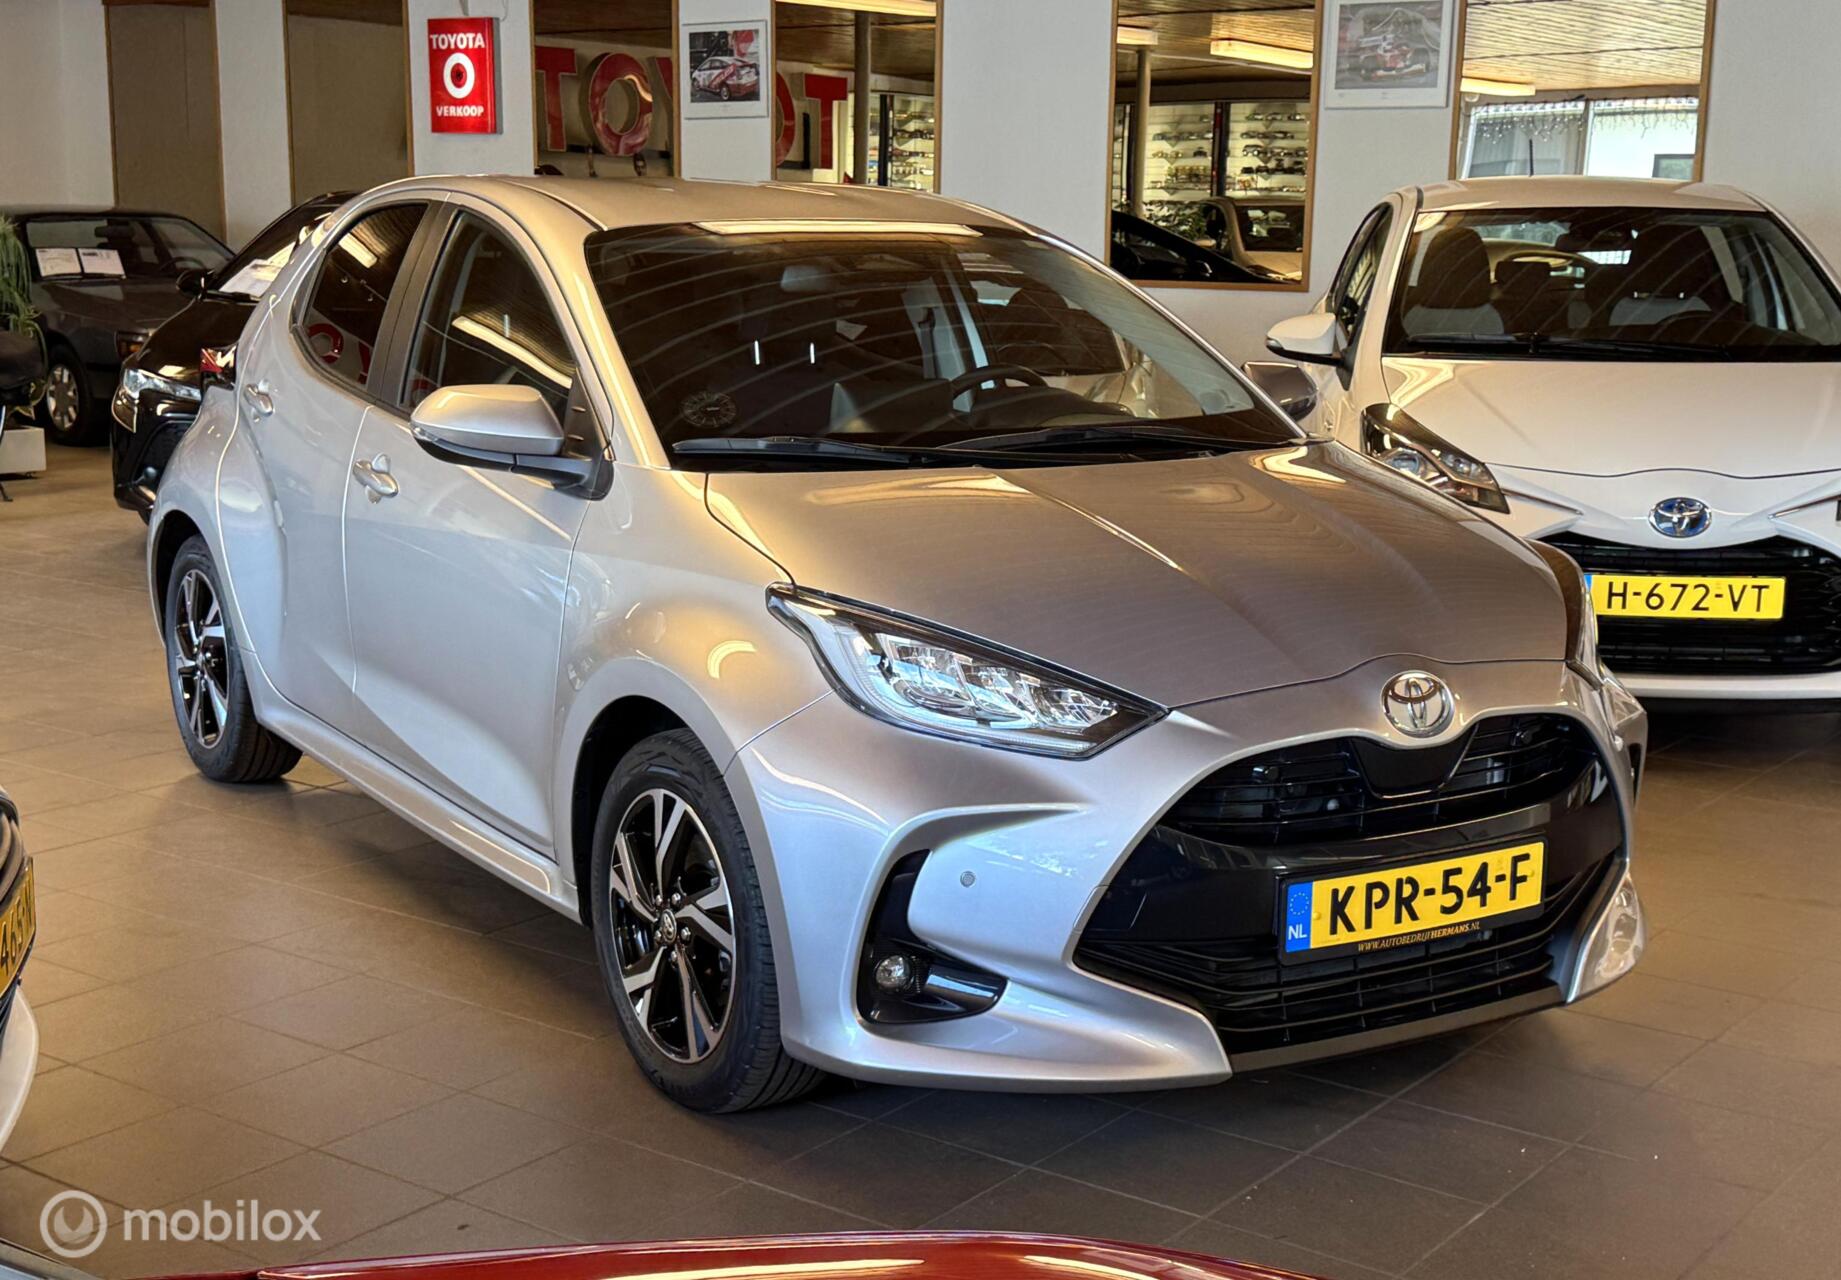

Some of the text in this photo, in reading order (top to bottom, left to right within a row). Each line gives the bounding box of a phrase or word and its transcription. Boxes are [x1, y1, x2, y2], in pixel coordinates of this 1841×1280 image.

[429, 32, 486, 50] TOYOTA
[436, 104, 485, 118] VERKOOP
[1606, 581, 1770, 613] H-672-VT
[1329, 852, 1532, 937] KPR-54-F
[1287, 923, 1308, 941] NL
